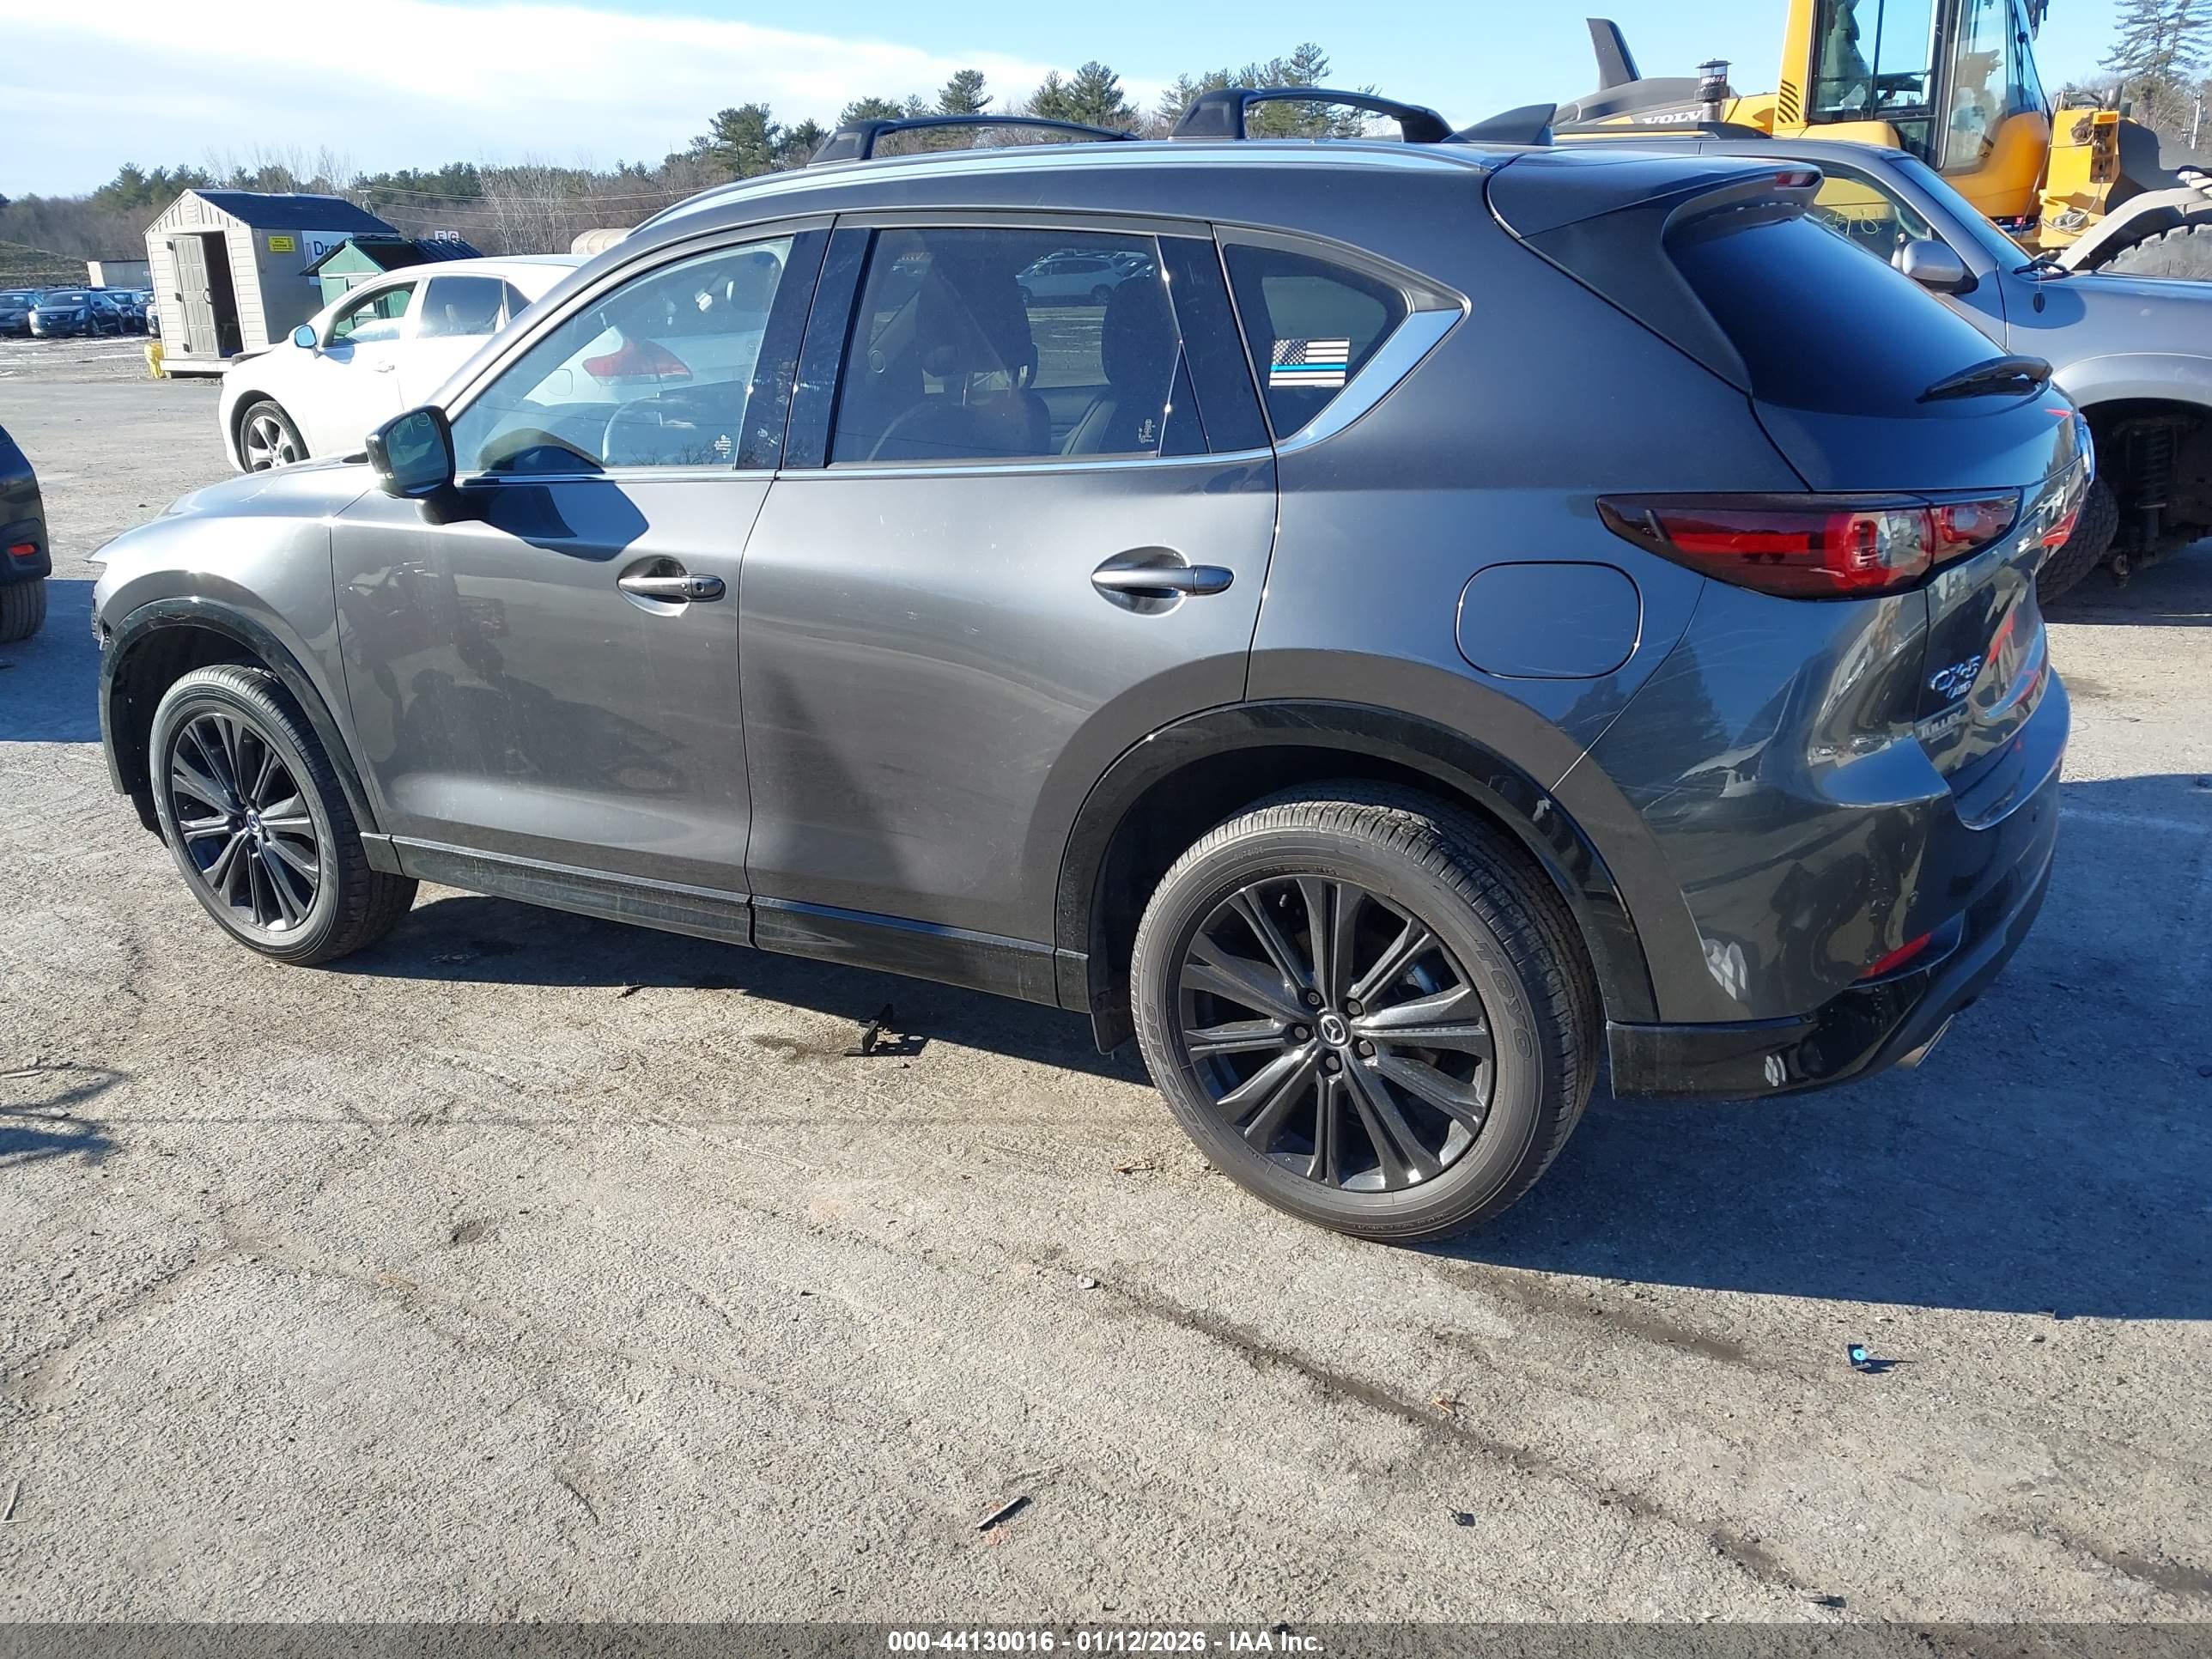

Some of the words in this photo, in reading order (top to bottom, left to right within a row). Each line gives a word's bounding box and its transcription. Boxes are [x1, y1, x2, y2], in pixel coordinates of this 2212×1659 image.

[1642, 110, 1704, 125] VOLV
[313, 240, 336, 256] Dr
[1474, 939, 1533, 1059] TOYO
